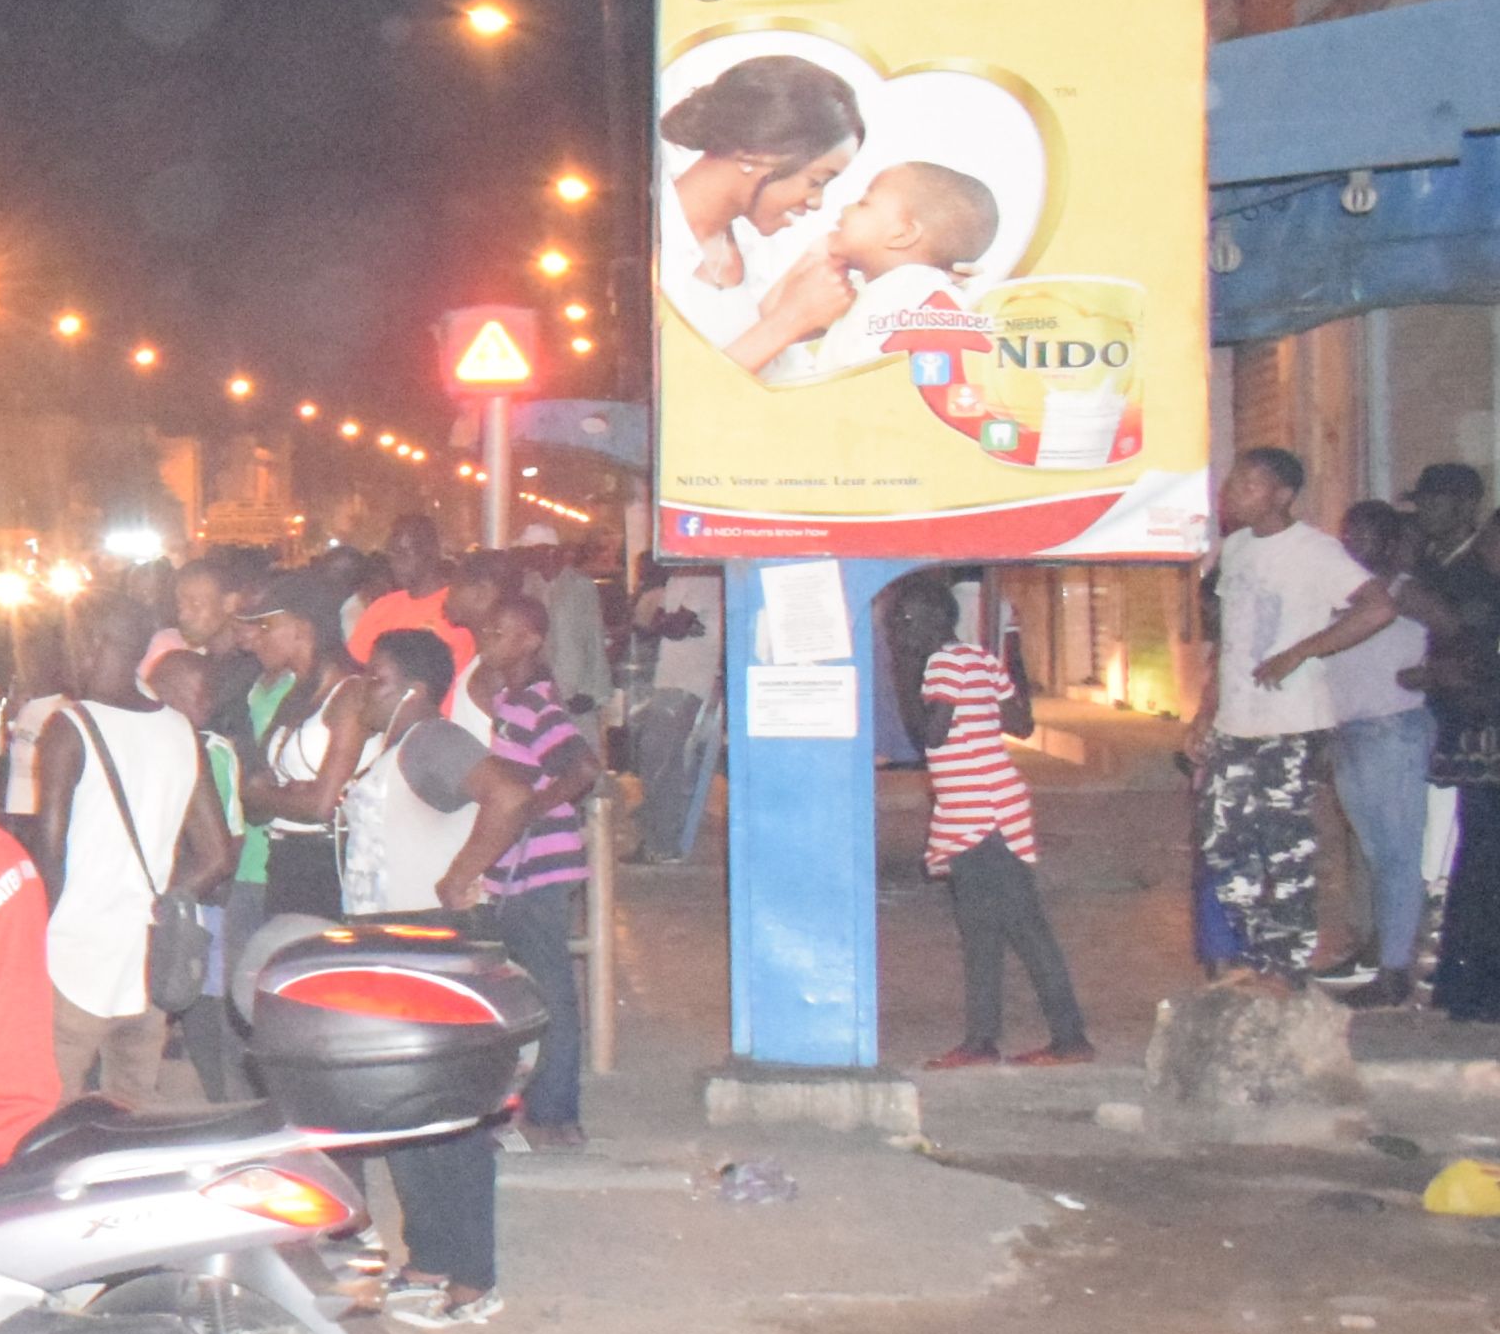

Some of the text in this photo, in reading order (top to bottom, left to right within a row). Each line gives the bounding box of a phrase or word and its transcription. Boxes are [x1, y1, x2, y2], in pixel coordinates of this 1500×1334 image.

[996, 335, 1130, 369] NIDO
[730, 475, 769, 487] Votre
[713, 527, 742, 537] NIDO
